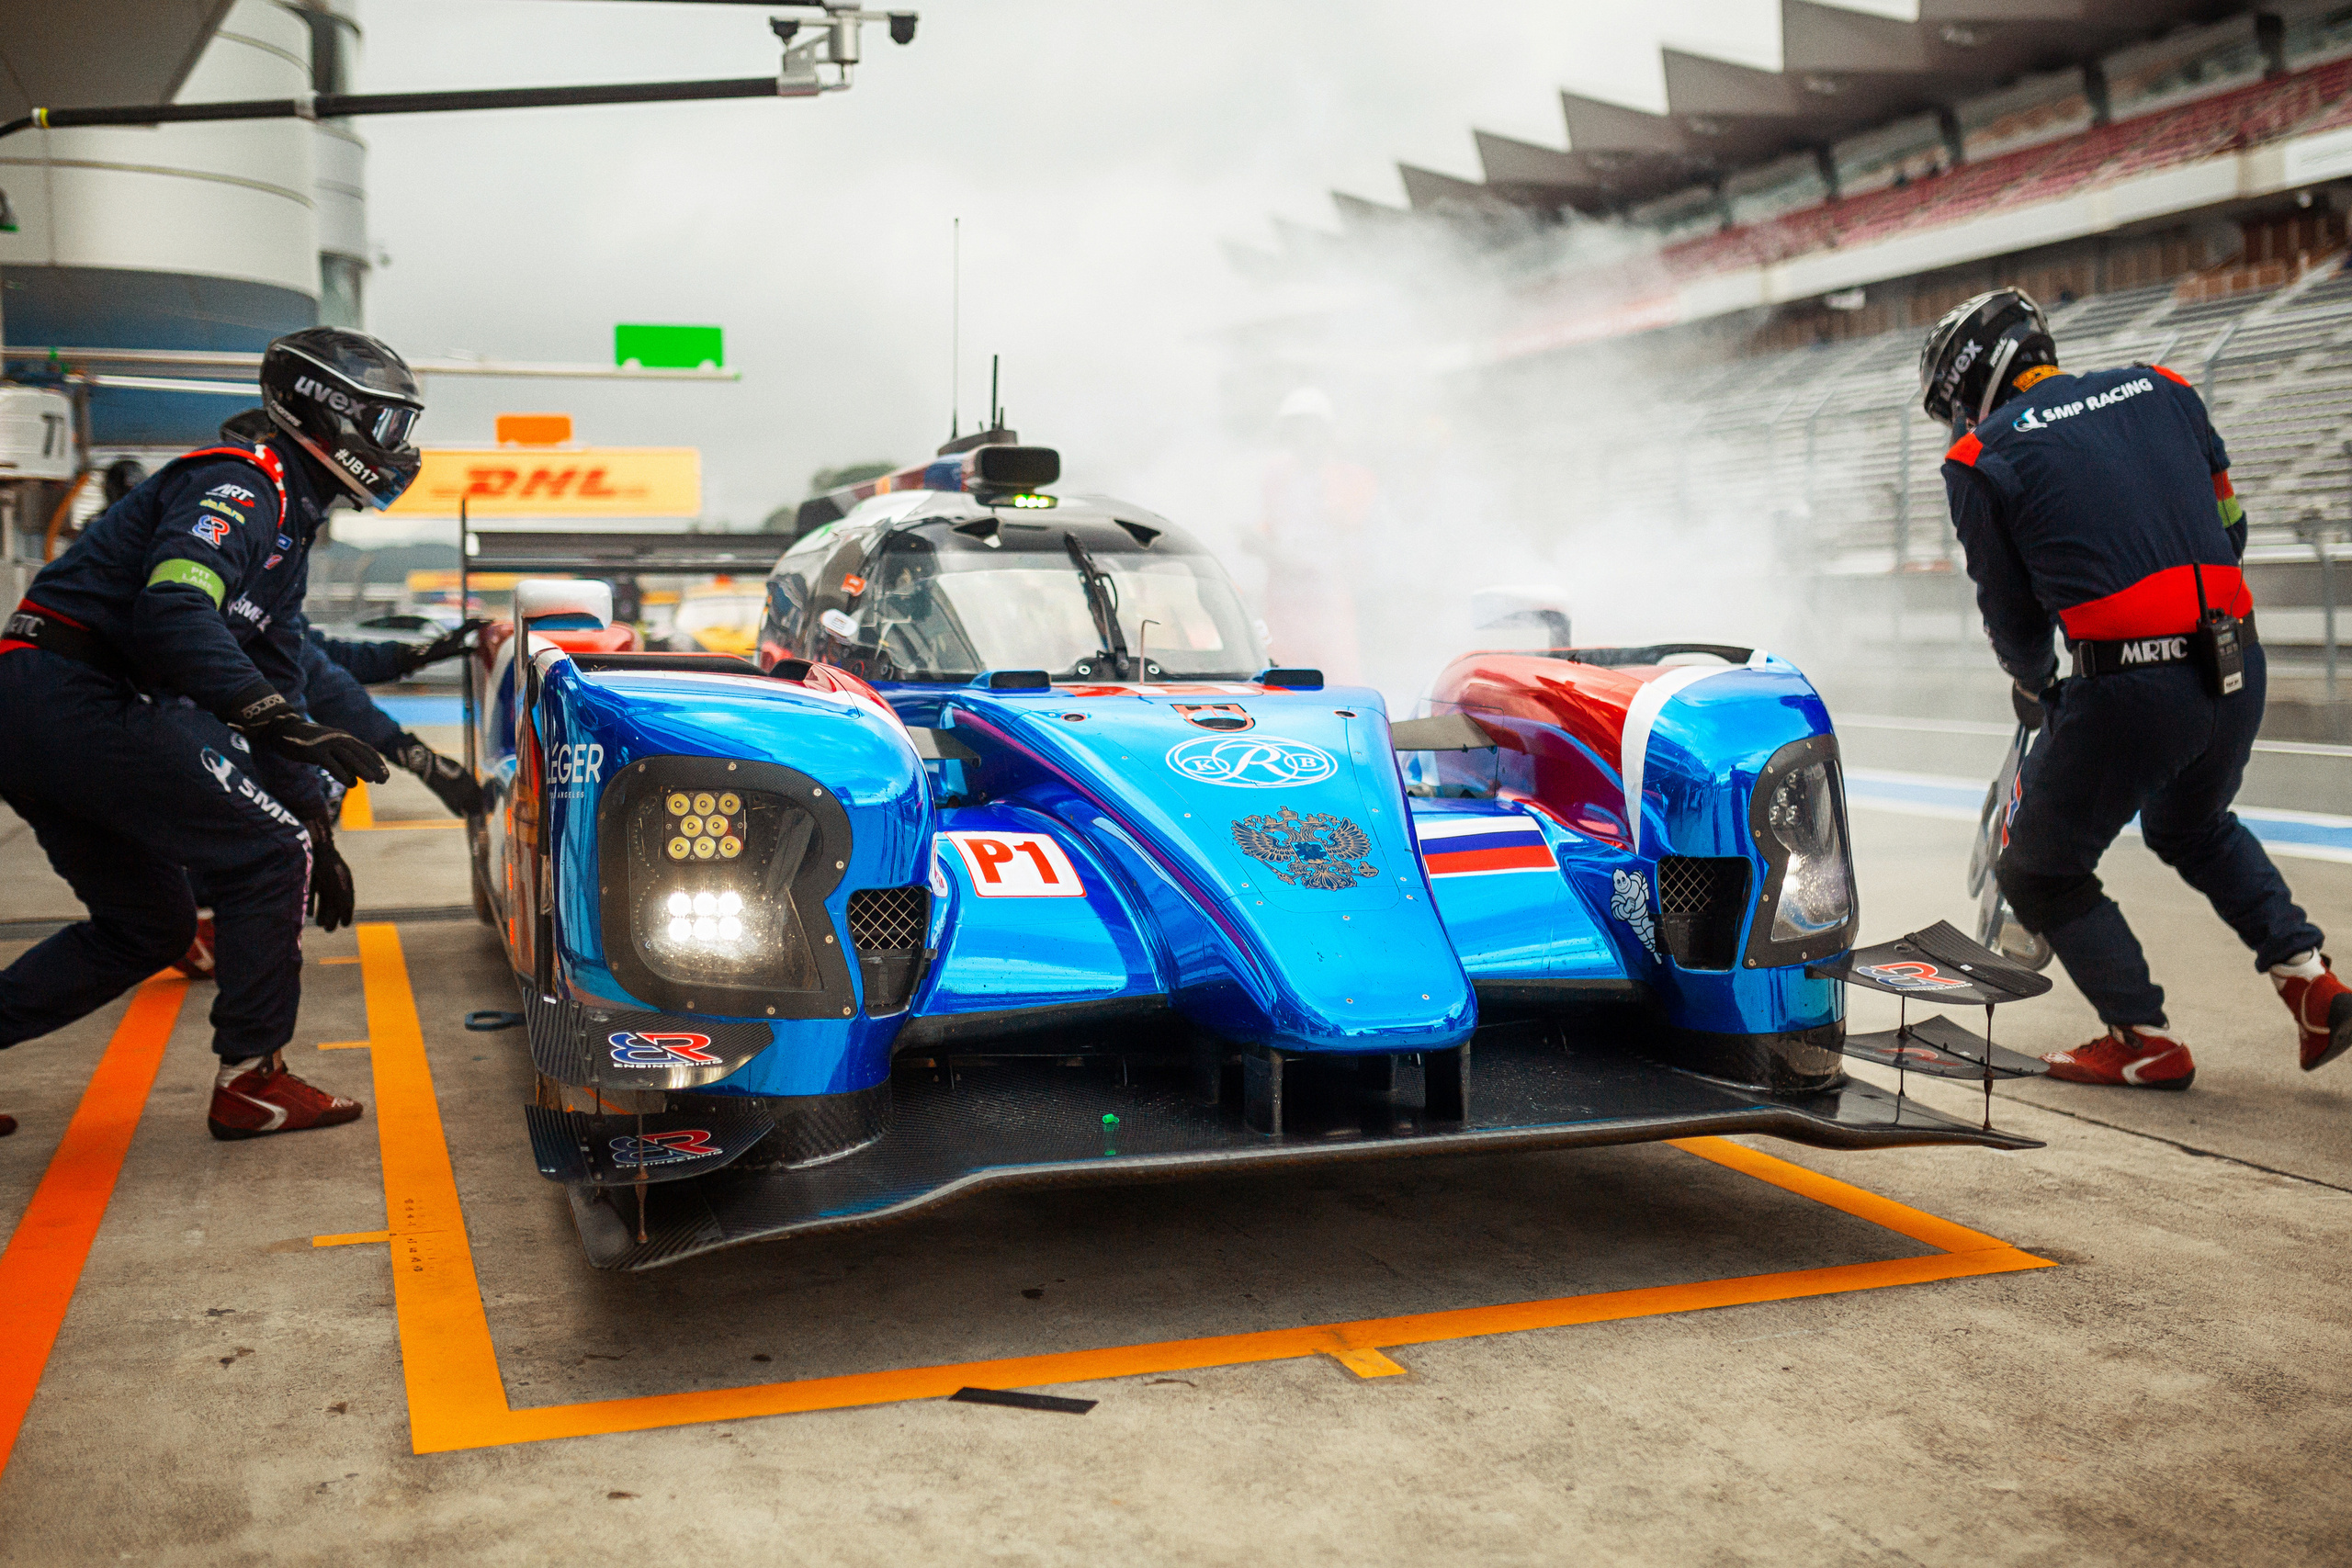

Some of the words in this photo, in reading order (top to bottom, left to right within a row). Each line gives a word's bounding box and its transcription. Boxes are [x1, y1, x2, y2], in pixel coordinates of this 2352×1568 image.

[1939, 338, 1984, 402] uvex
[294, 375, 367, 421] uvex
[2041, 401, 2085, 422] SMP
[2085, 378, 2154, 412] RACING
[334, 448, 380, 485] #JB17
[466, 467, 617, 499] DHL
[211, 483, 255, 502] ART
[190, 566, 210, 579] PIT
[2120, 636, 2188, 666] MRTC
[1192, 760, 1216, 771] K
[1299, 757, 1317, 768] B
[238, 777, 300, 827] SMP
[557, 791, 584, 799] ANGELES
[963, 838, 1060, 885] P1
